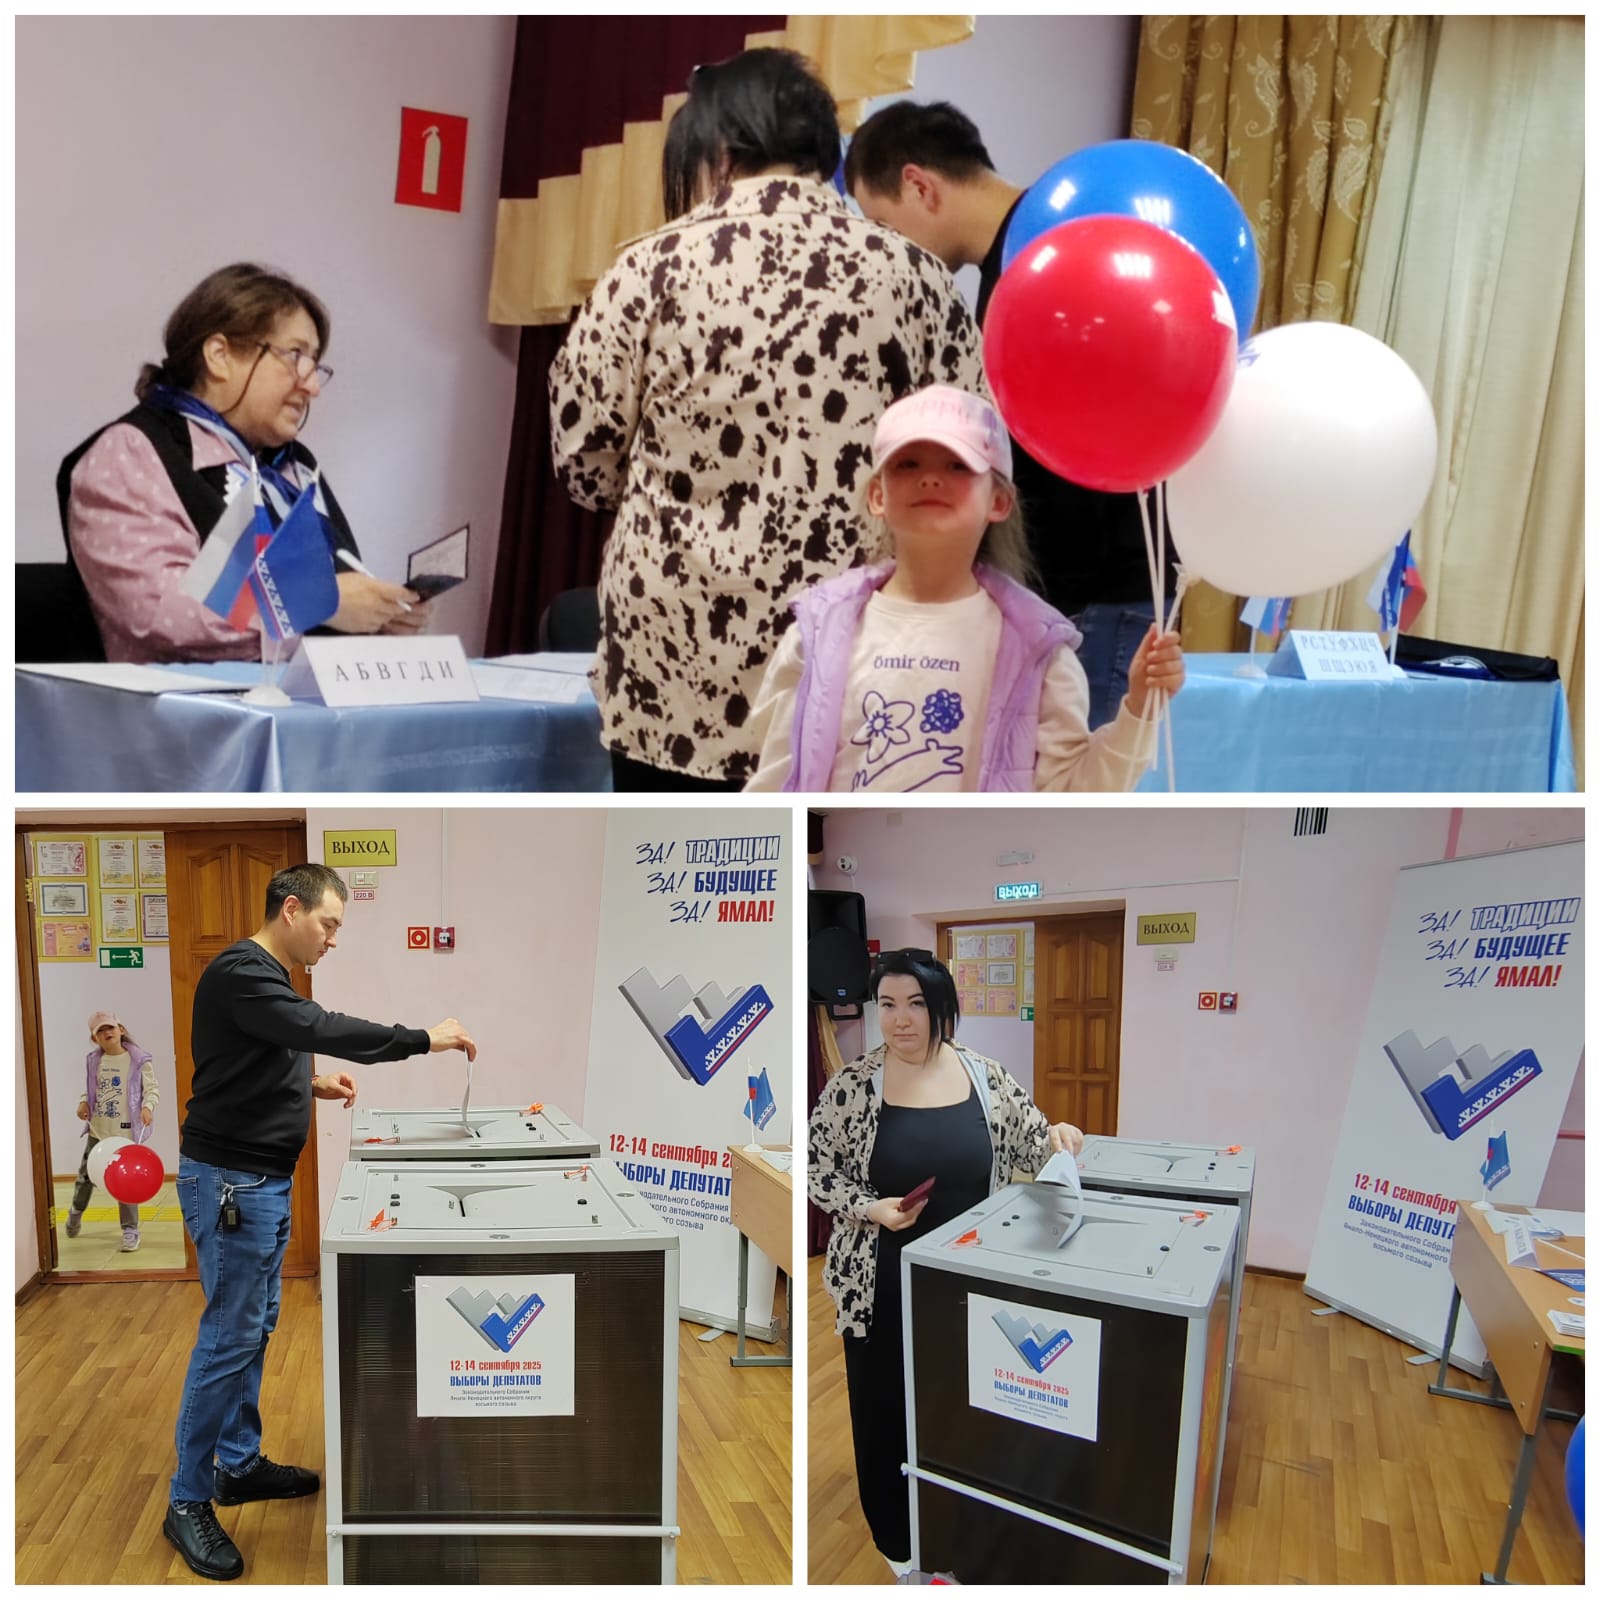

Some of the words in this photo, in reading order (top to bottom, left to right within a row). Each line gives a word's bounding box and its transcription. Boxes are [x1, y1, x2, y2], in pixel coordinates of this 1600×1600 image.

[874, 654, 916, 670] ömir
[920, 655, 960, 673] özen
[332, 840, 391, 856] ВЫХОД
[636, 841, 676, 865] ЗА!
[686, 835, 781, 867] ТРАДИЦИИ
[647, 871, 687, 894] ЗА!
[694, 869, 777, 896] БУДУЩЕЕ
[998, 884, 1038, 900] ВЫХОД
[670, 900, 711, 923] ЗА!
[717, 900, 775, 922] ЯМАЛ!
[1418, 909, 1462, 934] ЗА!
[1470, 897, 1582, 933] ТРАДИЦИИ
[1144, 921, 1190, 936] ВЫХОД
[1425, 937, 1469, 960] ЗА!
[1474, 932, 1572, 961] БУДУЩЕЕ
[1443, 965, 1491, 988] ЗА!
[1494, 964, 1563, 988] ЯМАЛ!
[610, 1133, 647, 1156] 12-14
[652, 1143, 718, 1169] сентября
[722, 1152, 732, 1169] 2
[1355, 1173, 1390, 1196] 12-14
[1392, 1185, 1457, 1215] сентября
[669, 1207, 718, 1222] автономного
[690, 1199, 729, 1212] Собрания
[1348, 1194, 1403, 1224] ВЫБОРЫ
[675, 1219, 704, 1231] созыва
[450, 1360, 475, 1371] 12-14
[479, 1360, 521, 1373] сентября
[522, 1361, 542, 1370] 2025
[994, 1368, 1015, 1381] 12-14
[450, 1375, 490, 1387] ВЫБОРЫ
[492, 1374, 542, 1388] ДЕПУТАТОВ
[994, 1380, 1026, 1396] ВЫБОРЫ
[1028, 1389, 1069, 1408] ДЕПУТАТОВ
